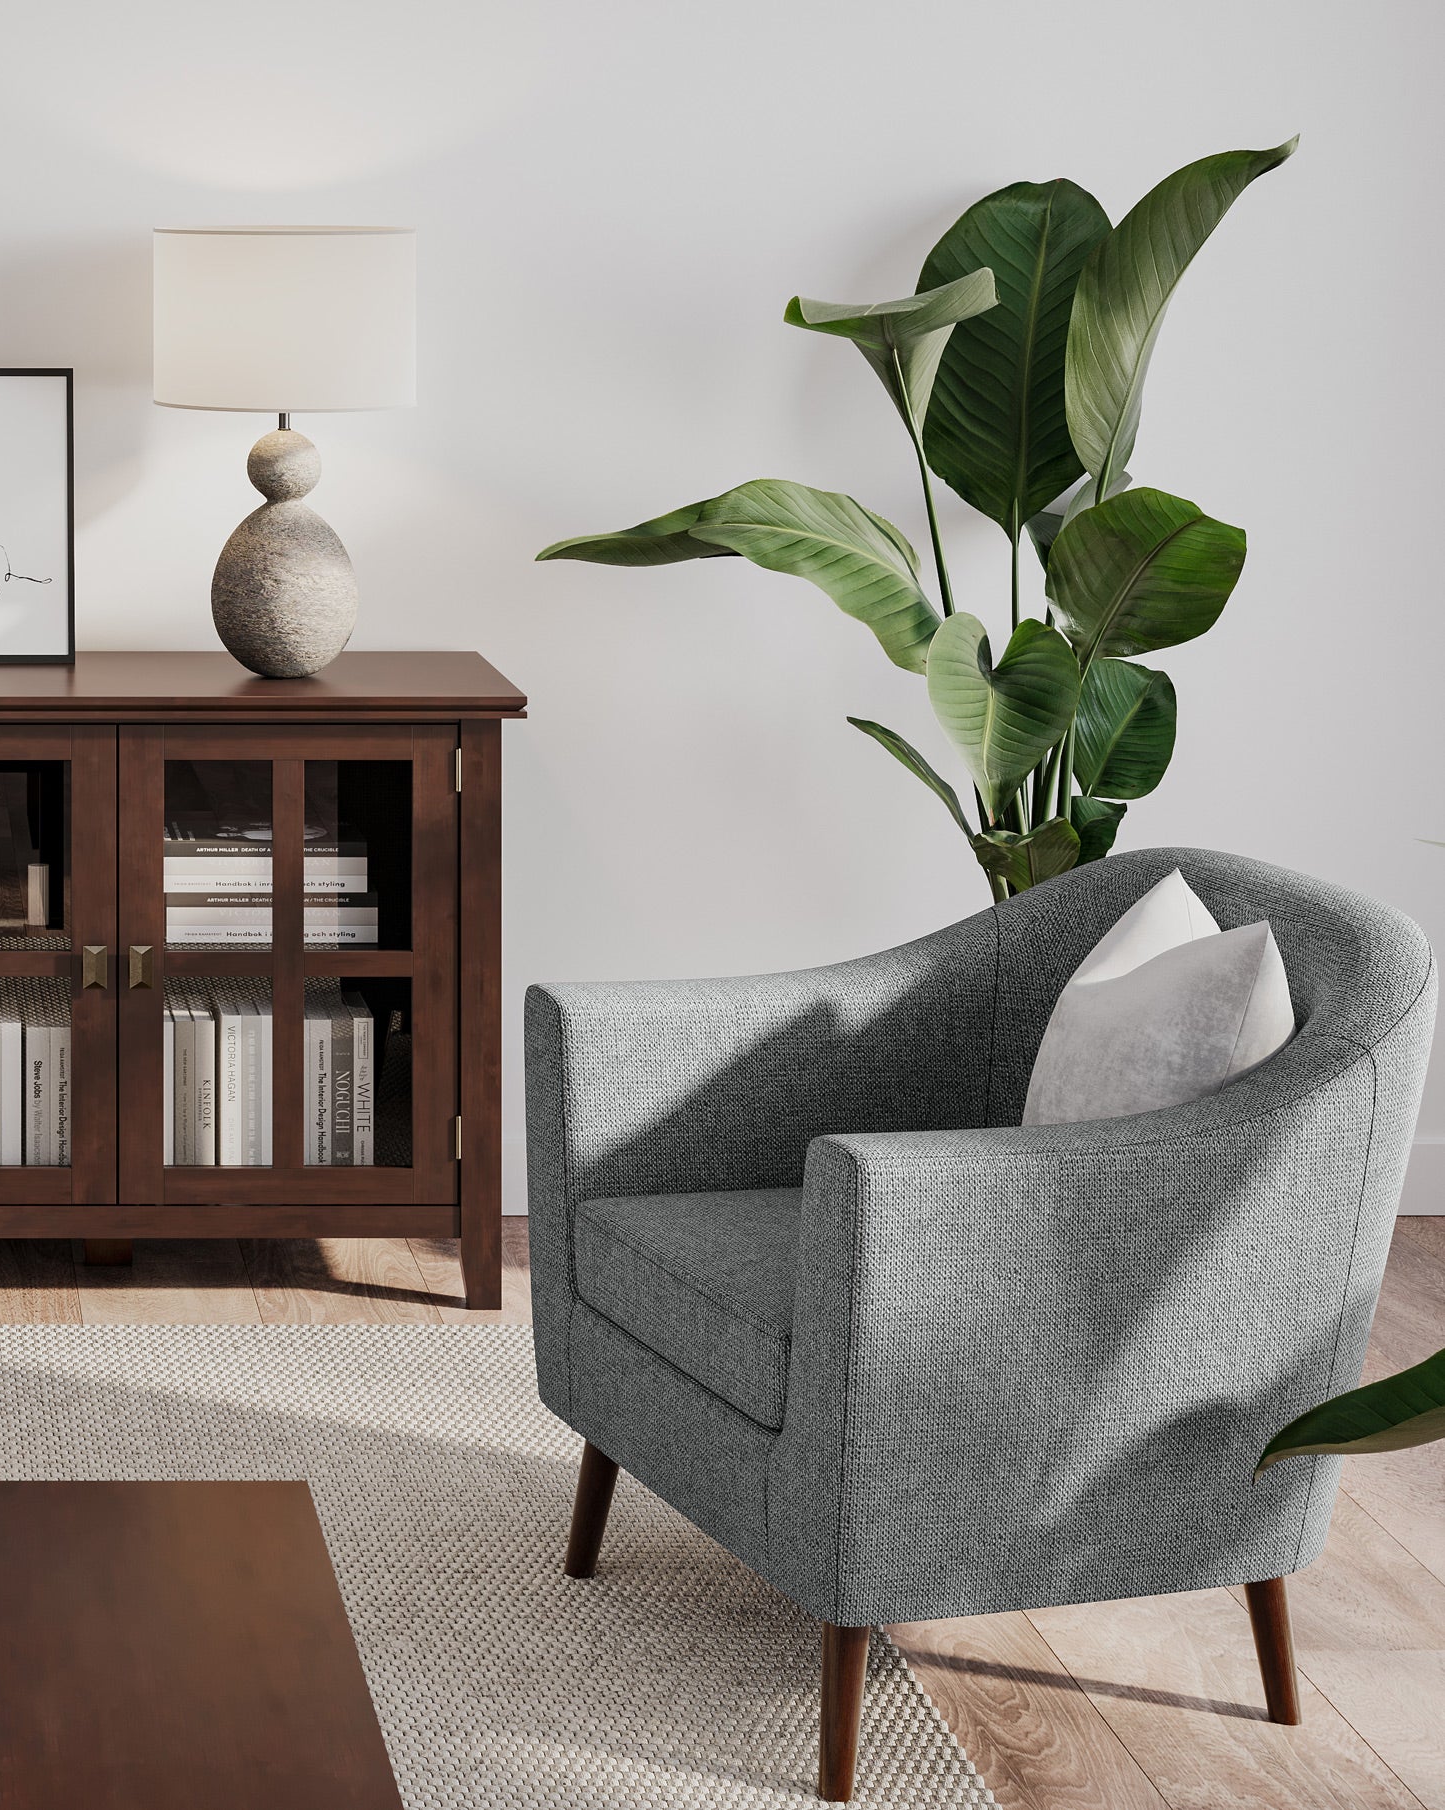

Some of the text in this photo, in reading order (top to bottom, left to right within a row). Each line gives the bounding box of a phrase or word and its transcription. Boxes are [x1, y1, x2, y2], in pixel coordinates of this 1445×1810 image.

[227, 1025, 236, 1068] VICTORIA
[33, 1060, 42, 1080] Steve
[317, 1073, 326, 1084] The
[33, 1081, 42, 1098] Jobs
[58, 1080, 67, 1092] The
[227, 1070, 236, 1102] HAGAN
[317, 1085, 326, 1108] Interior
[31, 1100, 42, 1109] by
[58, 1093, 67, 1116] Interior
[202, 1079, 211, 1129] KINFOLK
[335, 1070, 350, 1134] NOGUCHI
[356, 1082, 371, 1132] WHITE
[33, 1109, 42, 1131] Walter
[56, 1117, 67, 1138] Design
[316, 1108, 326, 1129] Design
[58, 1139, 67, 1165] Handbo
[317, 1131, 326, 1164] Handbook
